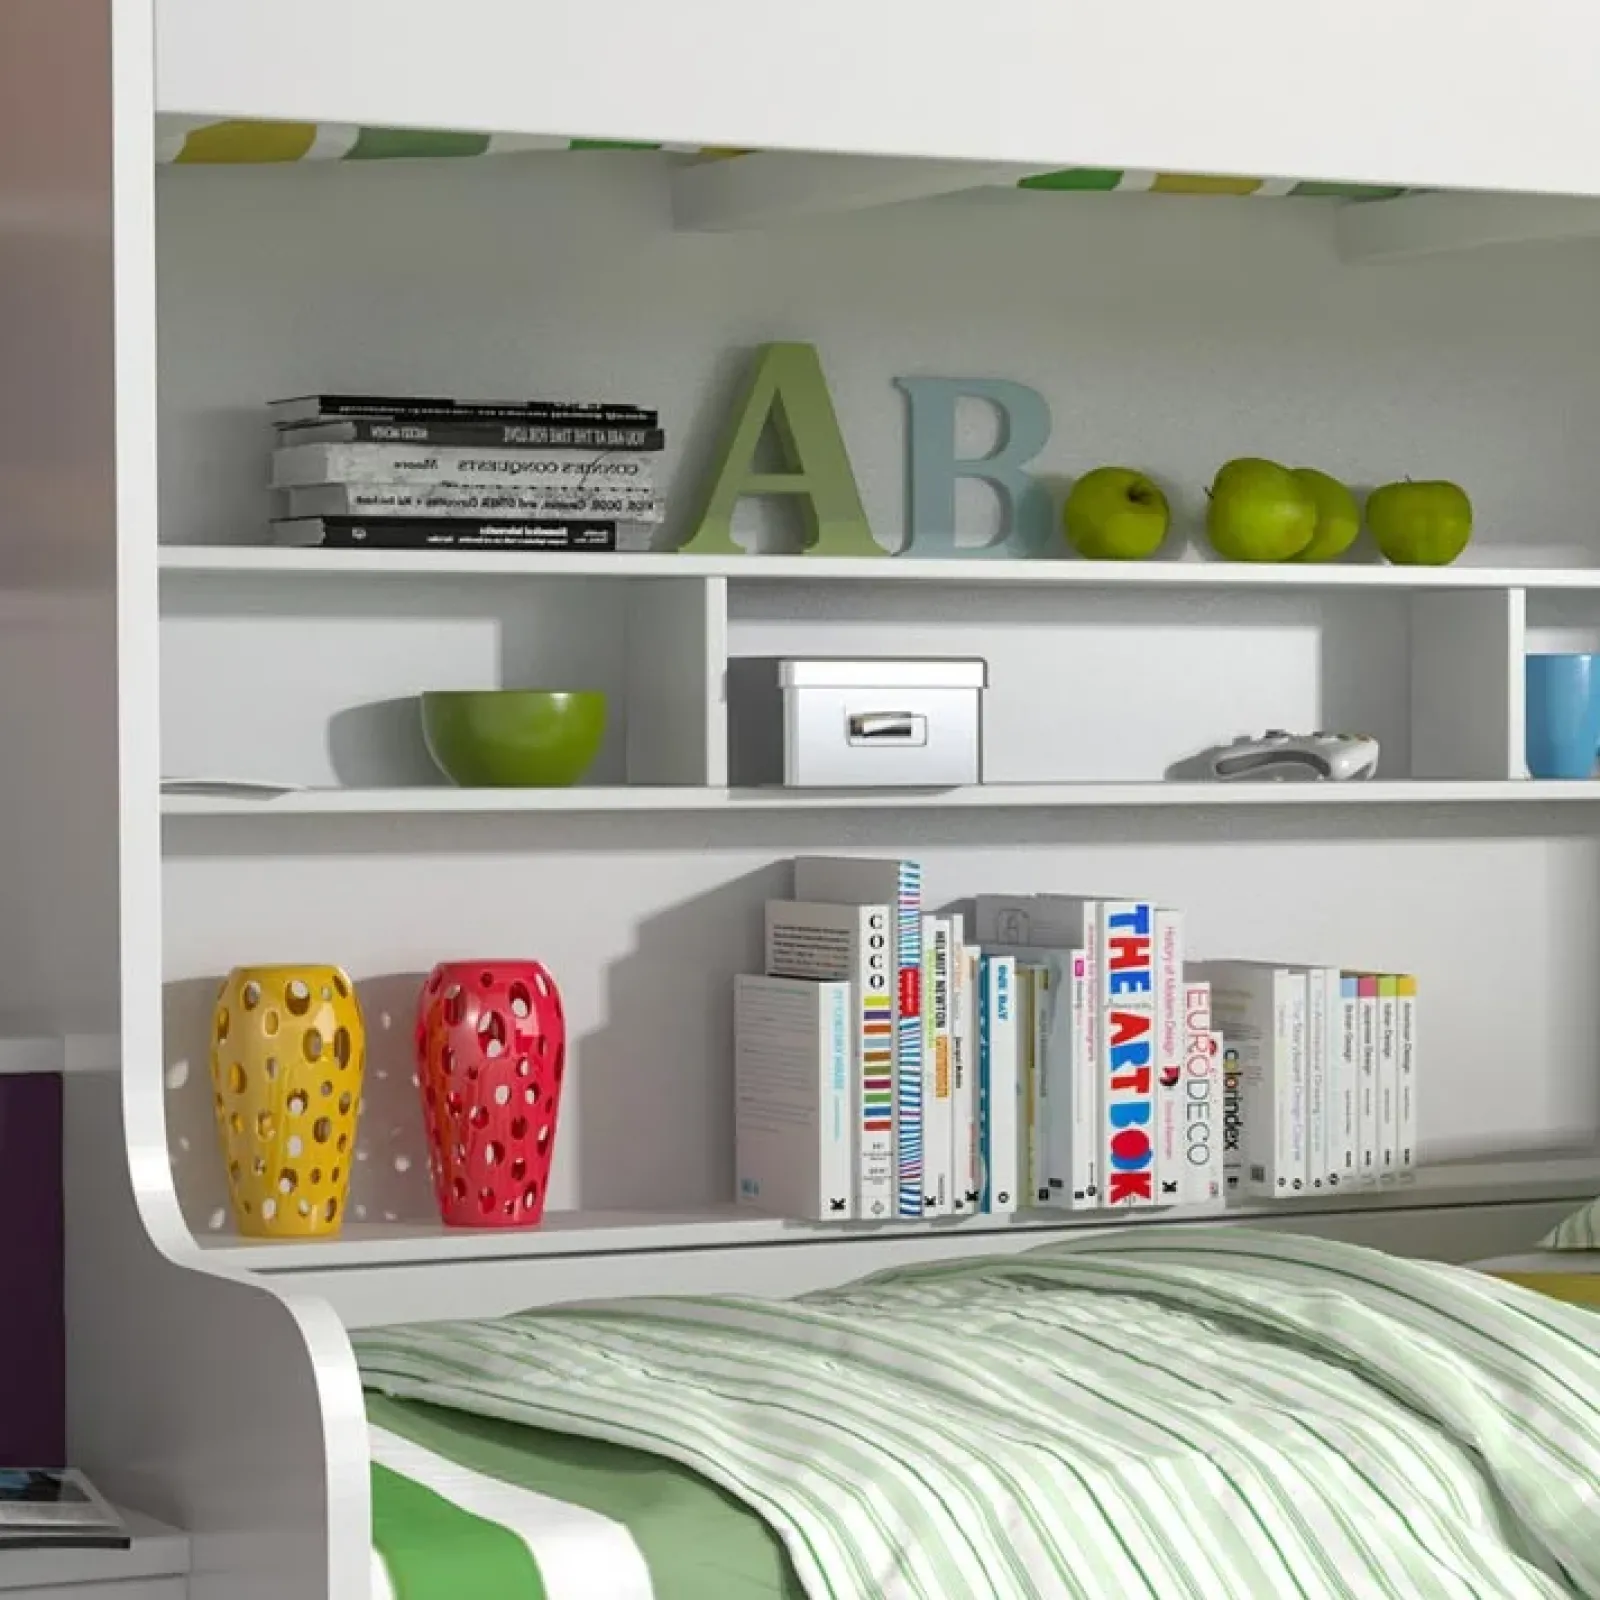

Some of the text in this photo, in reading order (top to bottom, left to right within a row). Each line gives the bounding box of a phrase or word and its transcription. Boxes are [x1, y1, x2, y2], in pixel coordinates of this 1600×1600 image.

[935, 930, 946, 977] HELMUT
[1109, 905, 1150, 994] THE
[935, 979, 946, 1029] NEWTON
[1110, 1012, 1150, 1093] ART
[1187, 989, 1210, 1166] EURODECO
[1223, 1049, 1244, 1151] colorindex
